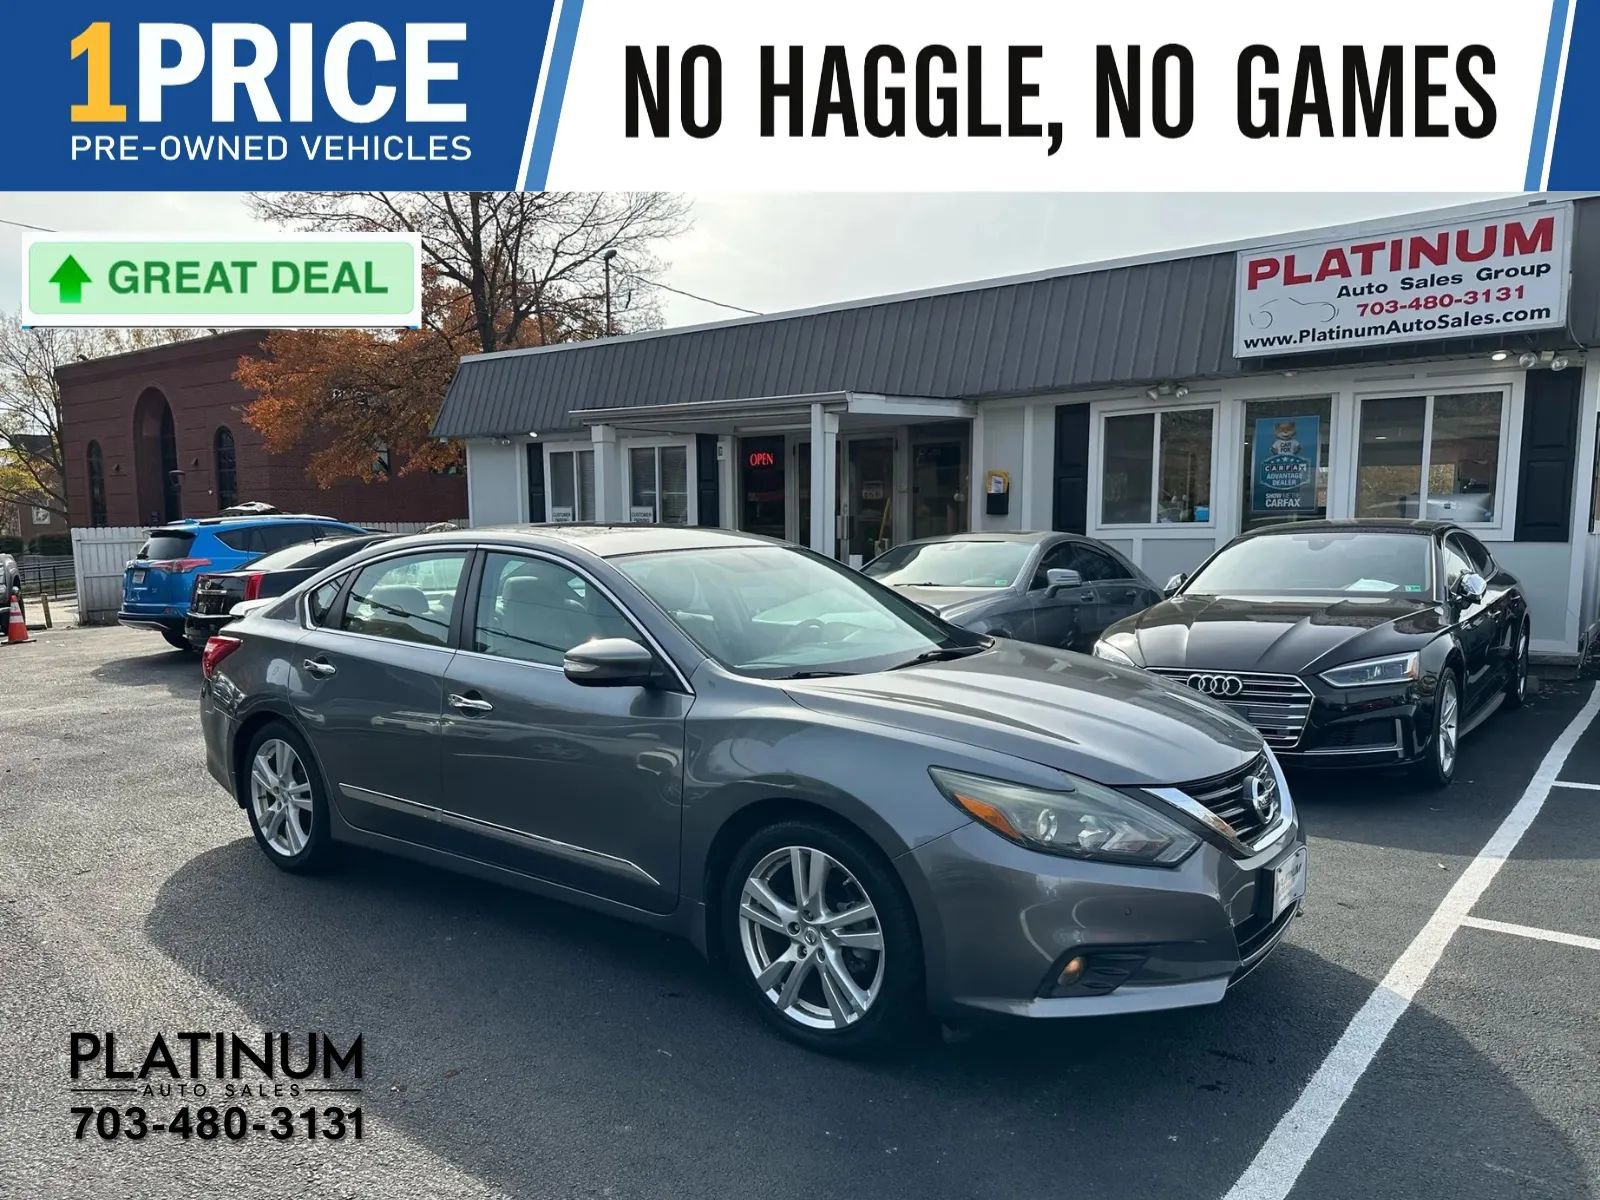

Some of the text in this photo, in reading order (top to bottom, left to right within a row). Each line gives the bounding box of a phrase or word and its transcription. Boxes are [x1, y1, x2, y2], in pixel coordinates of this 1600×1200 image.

[1247, 217, 1555, 291] PLATINUM
[1336, 262, 1551, 299] Auto Sales Group
[1356, 285, 1526, 317] 703-480-3131
[1244, 306, 1551, 349] www.PlatinumAutoSales.com
[750, 453, 774, 466] OPEN
[1265, 464, 1306, 472] CARFAX
[1265, 499, 1300, 508] CARFAX
